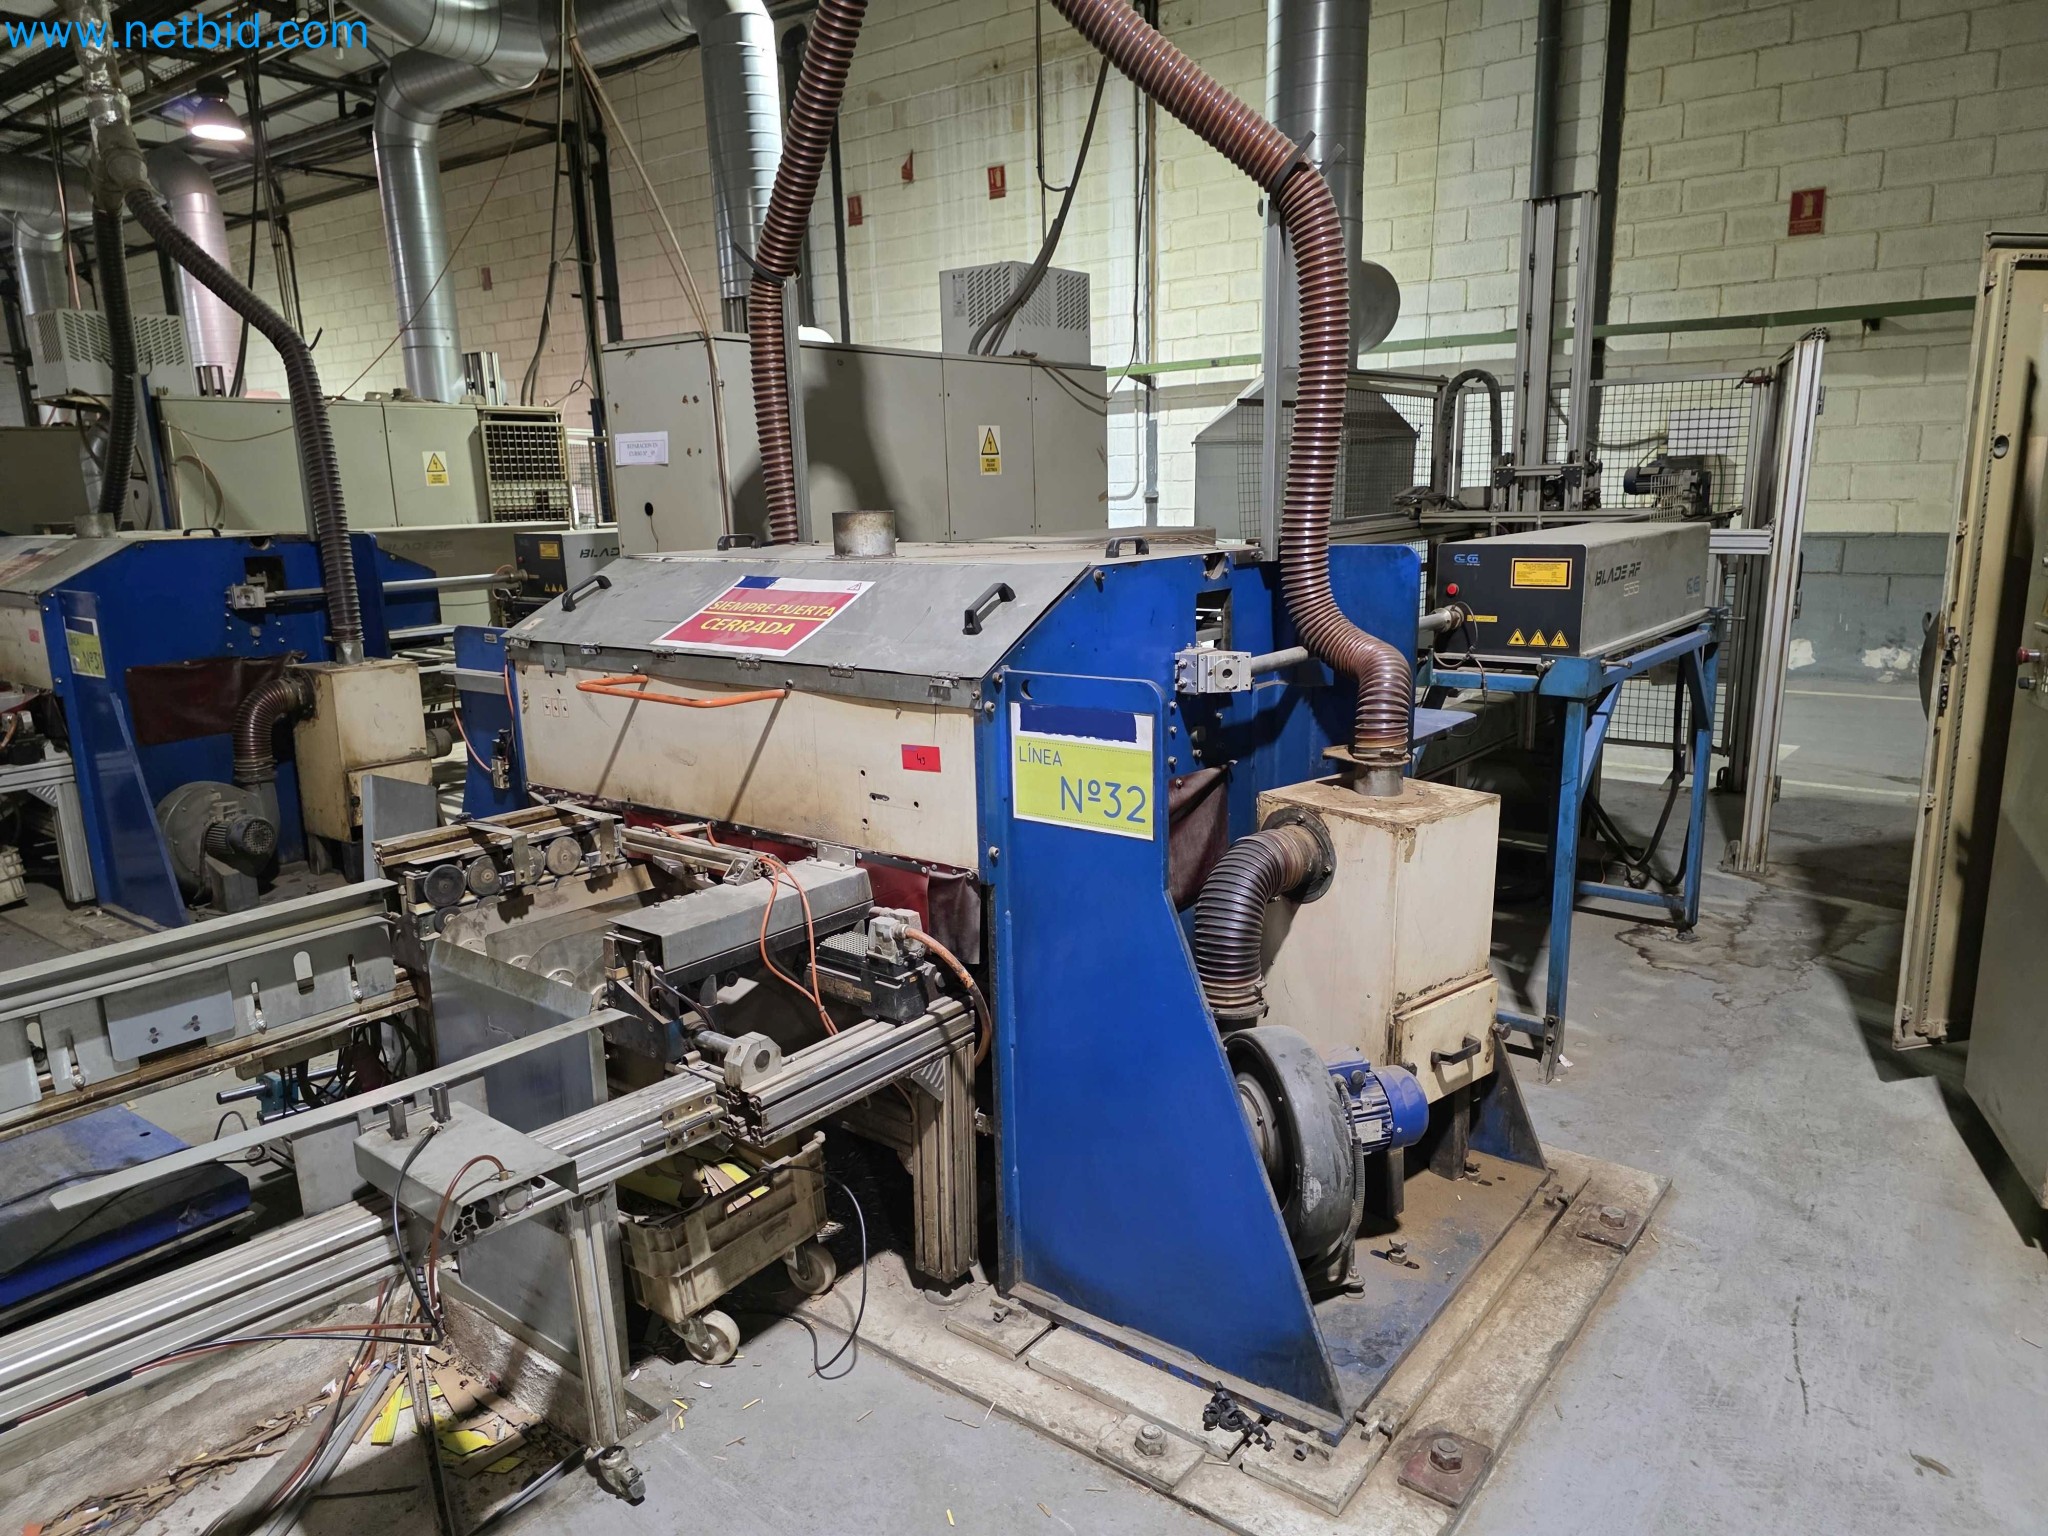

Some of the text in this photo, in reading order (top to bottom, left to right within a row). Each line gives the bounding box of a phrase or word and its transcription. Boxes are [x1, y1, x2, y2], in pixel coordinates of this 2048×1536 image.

[1594, 561, 1642, 587] BLADE RF
[708, 600, 836, 617] SIEMPRE PUERTA
[700, 618, 796, 636] CERRADA
[1019, 743, 1063, 767] LÍNEA
[1060, 776, 1146, 824] Nº32
